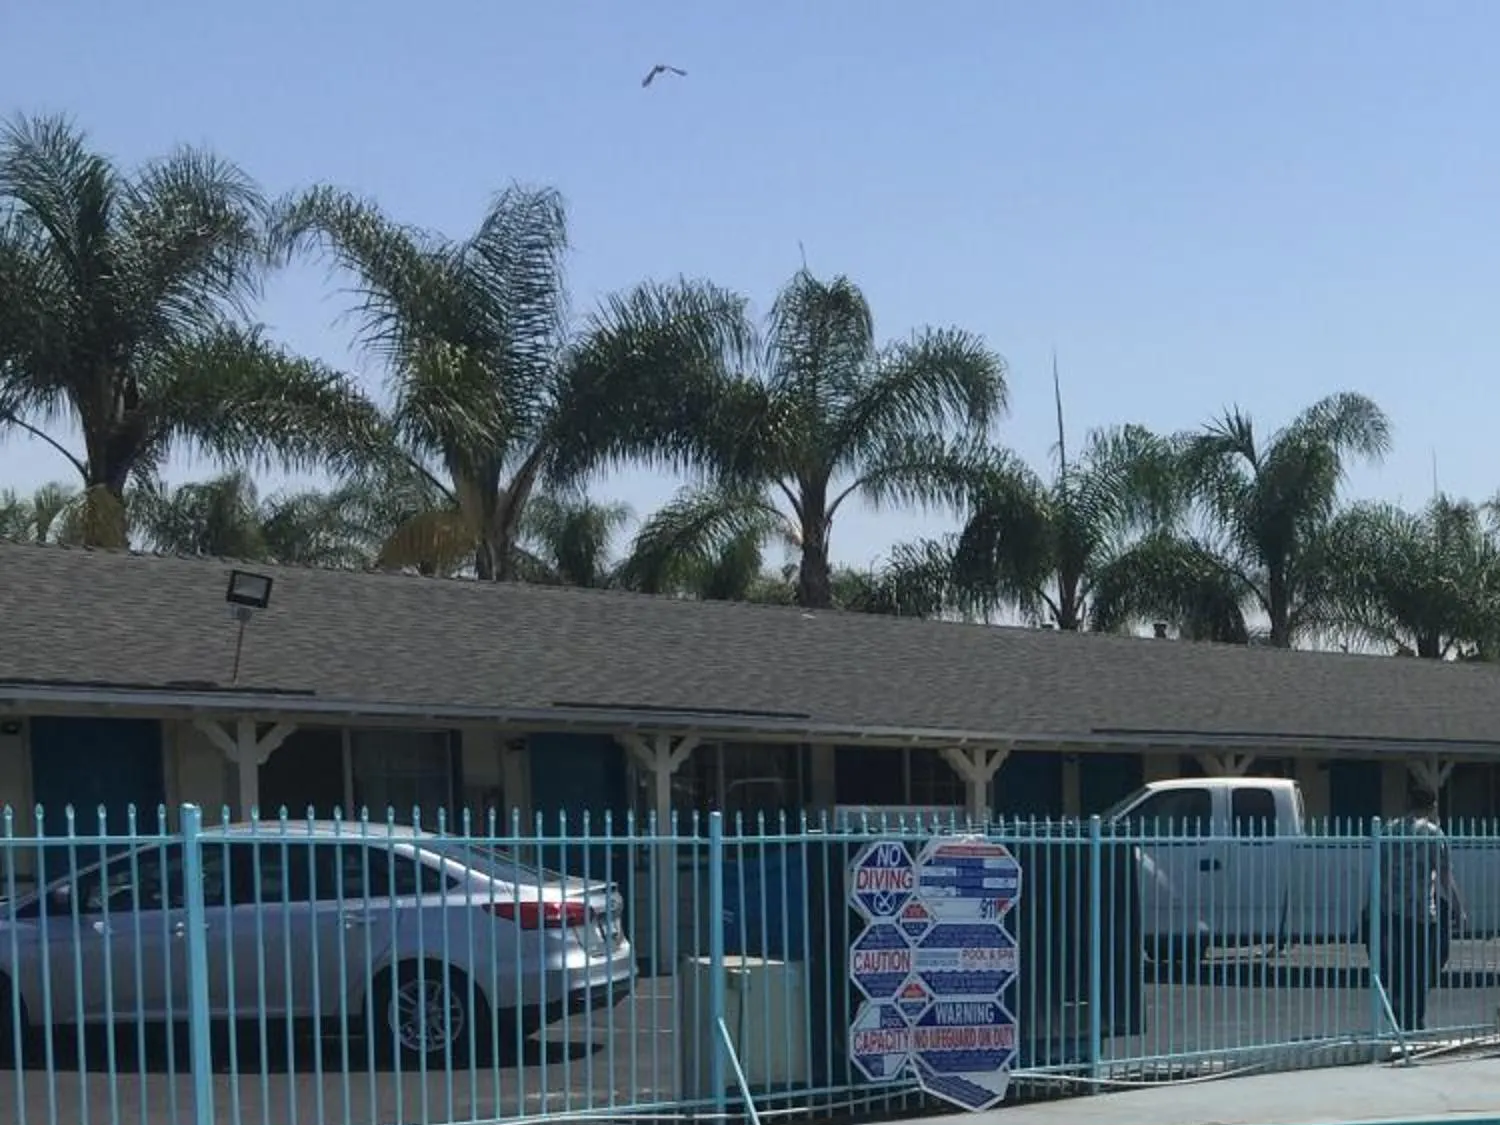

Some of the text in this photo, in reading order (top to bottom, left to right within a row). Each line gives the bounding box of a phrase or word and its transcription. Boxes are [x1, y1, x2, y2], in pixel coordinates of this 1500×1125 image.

[876, 846, 901, 867] NO
[857, 867, 913, 890] DIVING
[854, 950, 911, 973] CAUTION
[935, 1003, 994, 1024] WARNING
[855, 1030, 909, 1053] CAPACITY
[929, 1027, 976, 1049] LIFEGUARD
